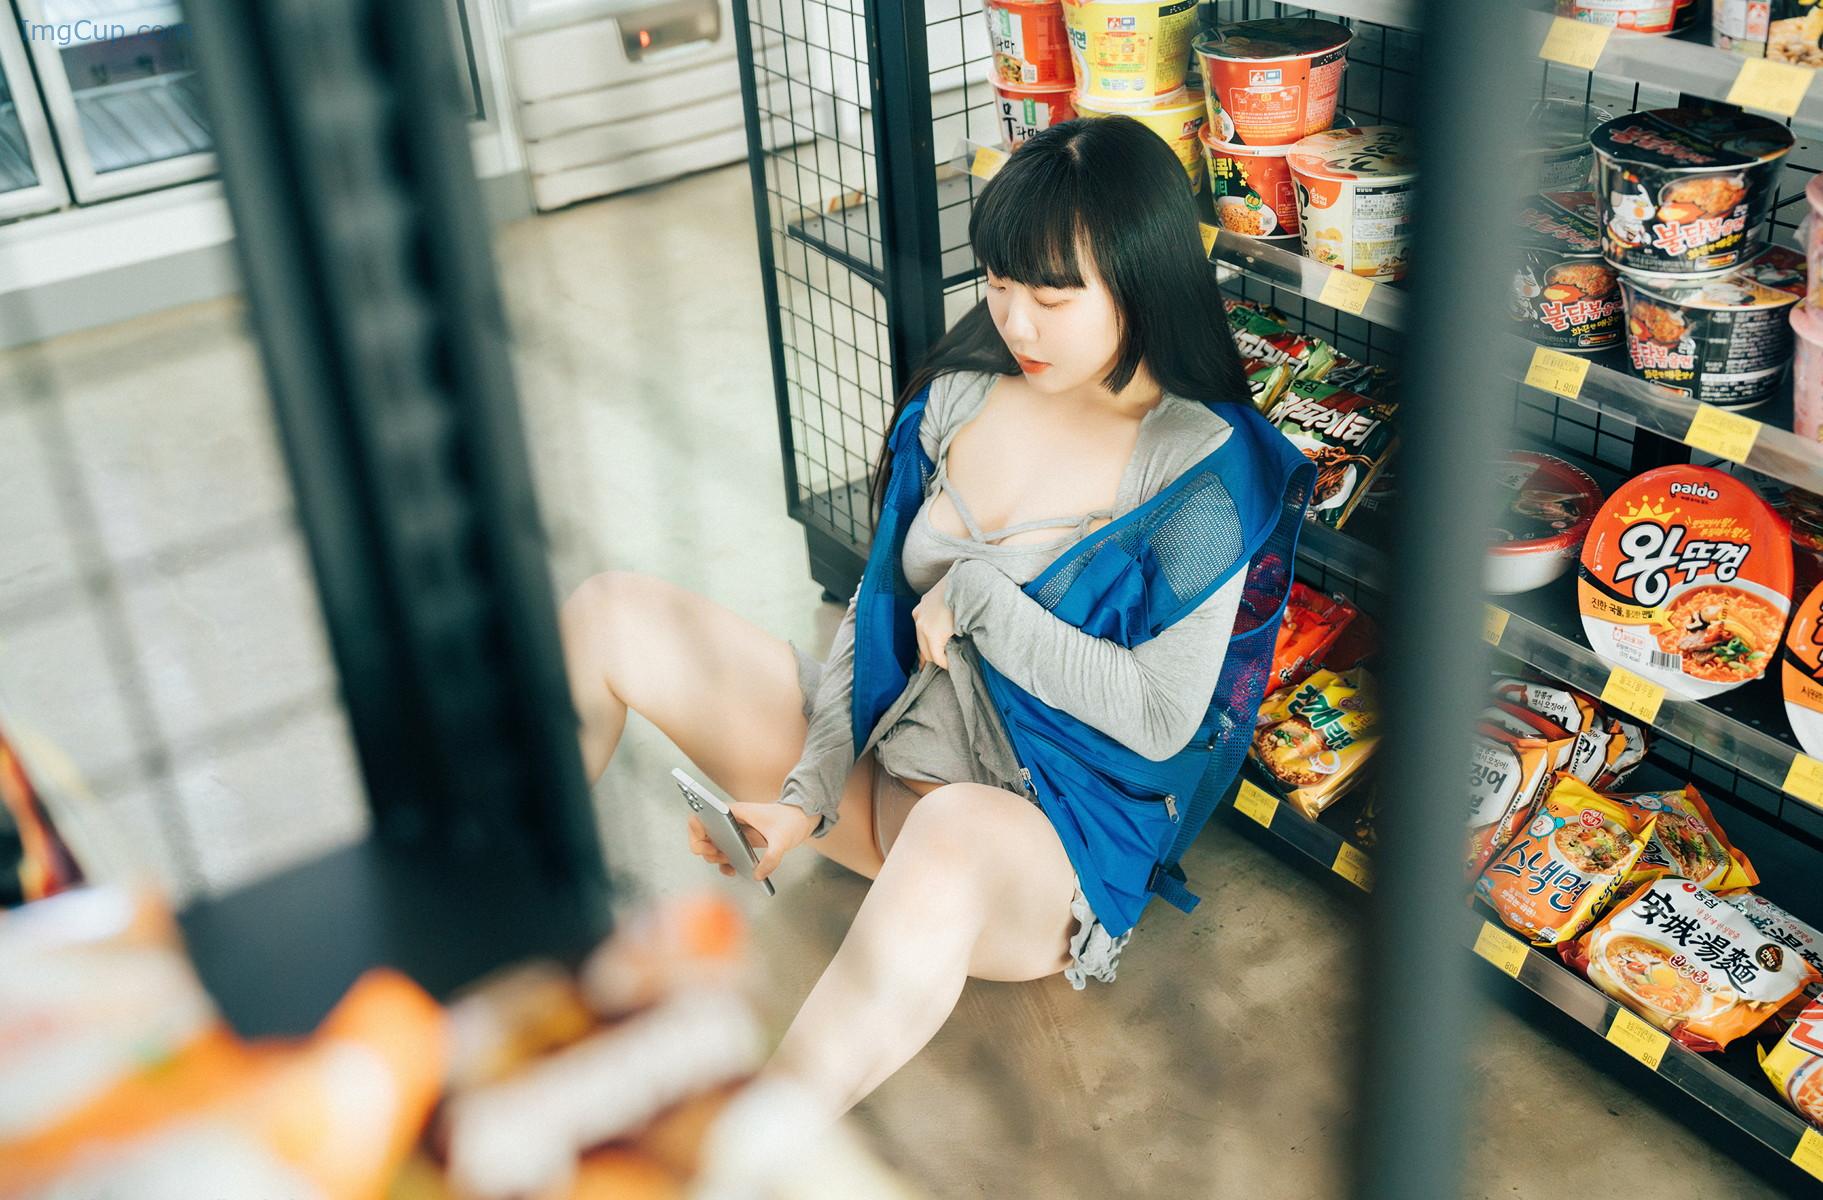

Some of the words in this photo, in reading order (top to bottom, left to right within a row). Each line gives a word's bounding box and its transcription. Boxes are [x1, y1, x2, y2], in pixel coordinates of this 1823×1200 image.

[1670, 482, 1719, 500] paldo
[1613, 522, 1752, 608] 왕뚜껑
[1592, 597, 1608, 612] 진한
[1544, 700, 1568, 713] 오징어!
[1492, 840, 1592, 912] 스낵면
[1694, 890, 1719, 909] 농심
[1504, 961, 1520, 976] 800
[1642, 1051, 1658, 1068] 900
